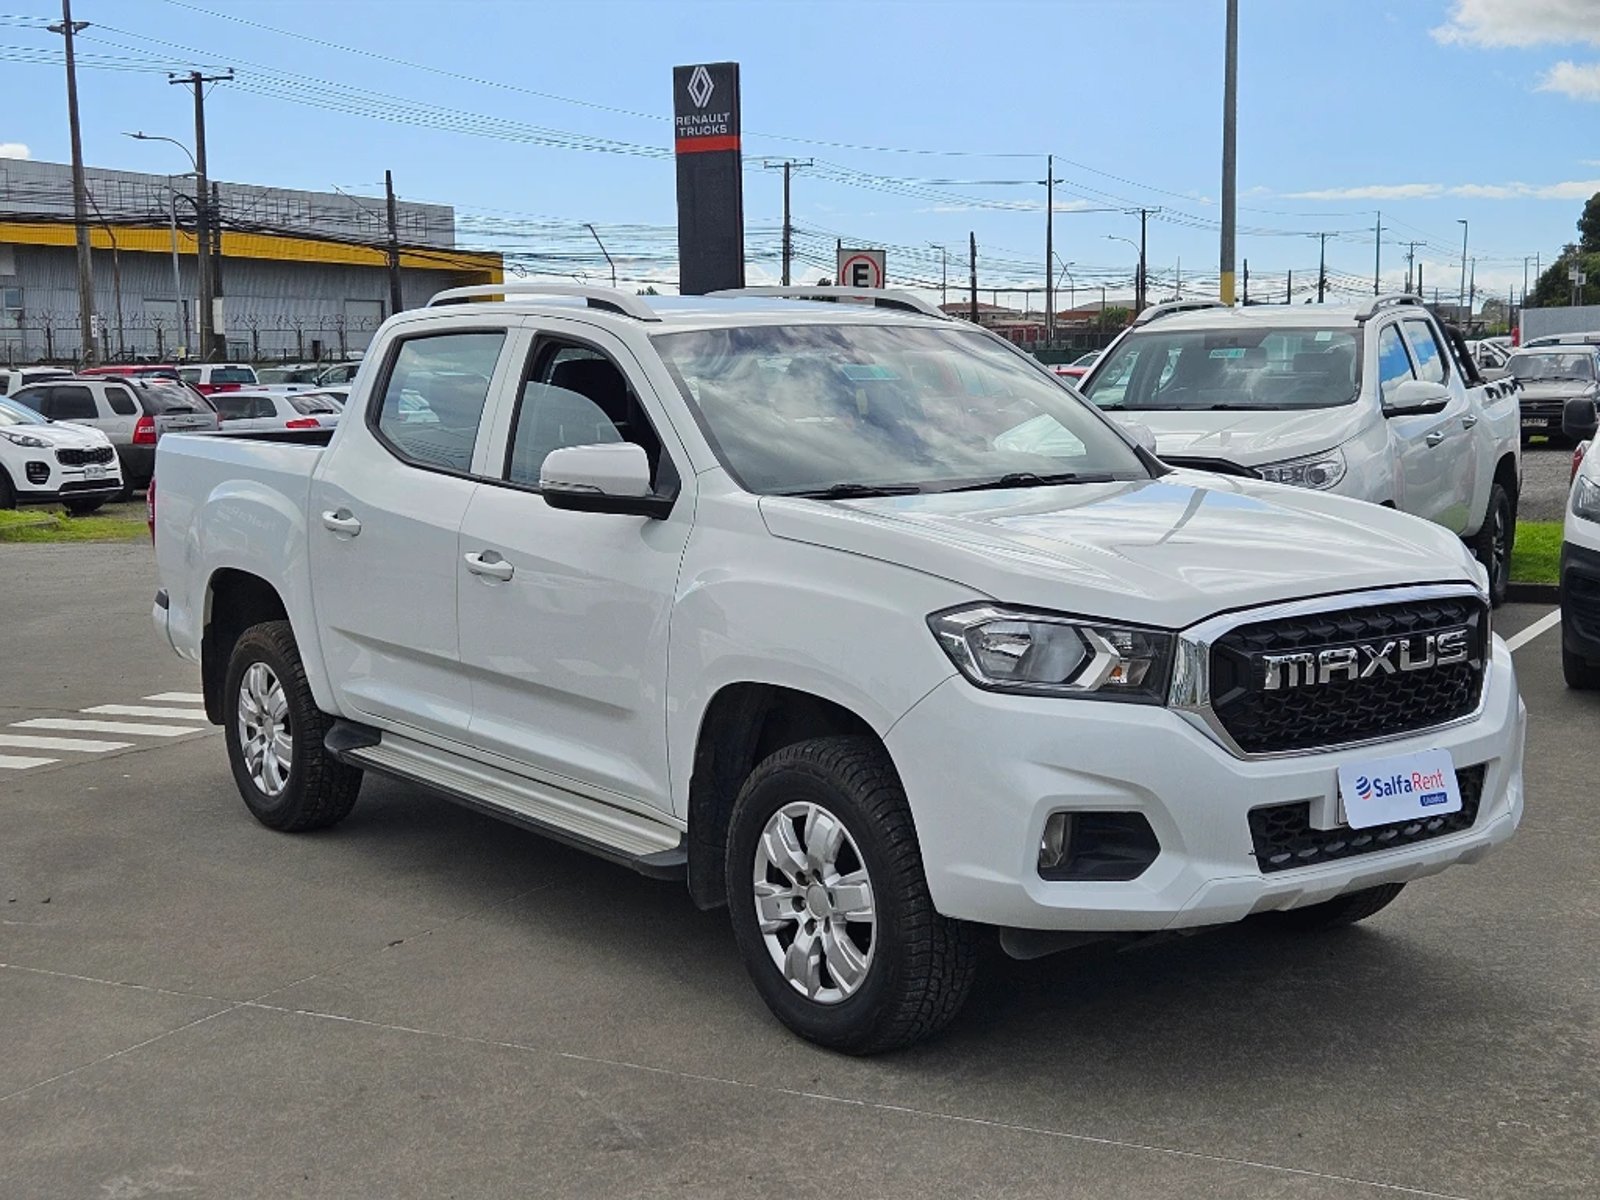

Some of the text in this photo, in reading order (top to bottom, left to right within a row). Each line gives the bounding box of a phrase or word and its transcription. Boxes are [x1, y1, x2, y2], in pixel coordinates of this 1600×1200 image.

[676, 112, 730, 126] RENAULT
[679, 125, 728, 136] TRUCKS
[853, 264, 869, 287] E
[1263, 629, 1468, 690] MAXUS
[1373, 768, 1445, 798] SalfaRent
